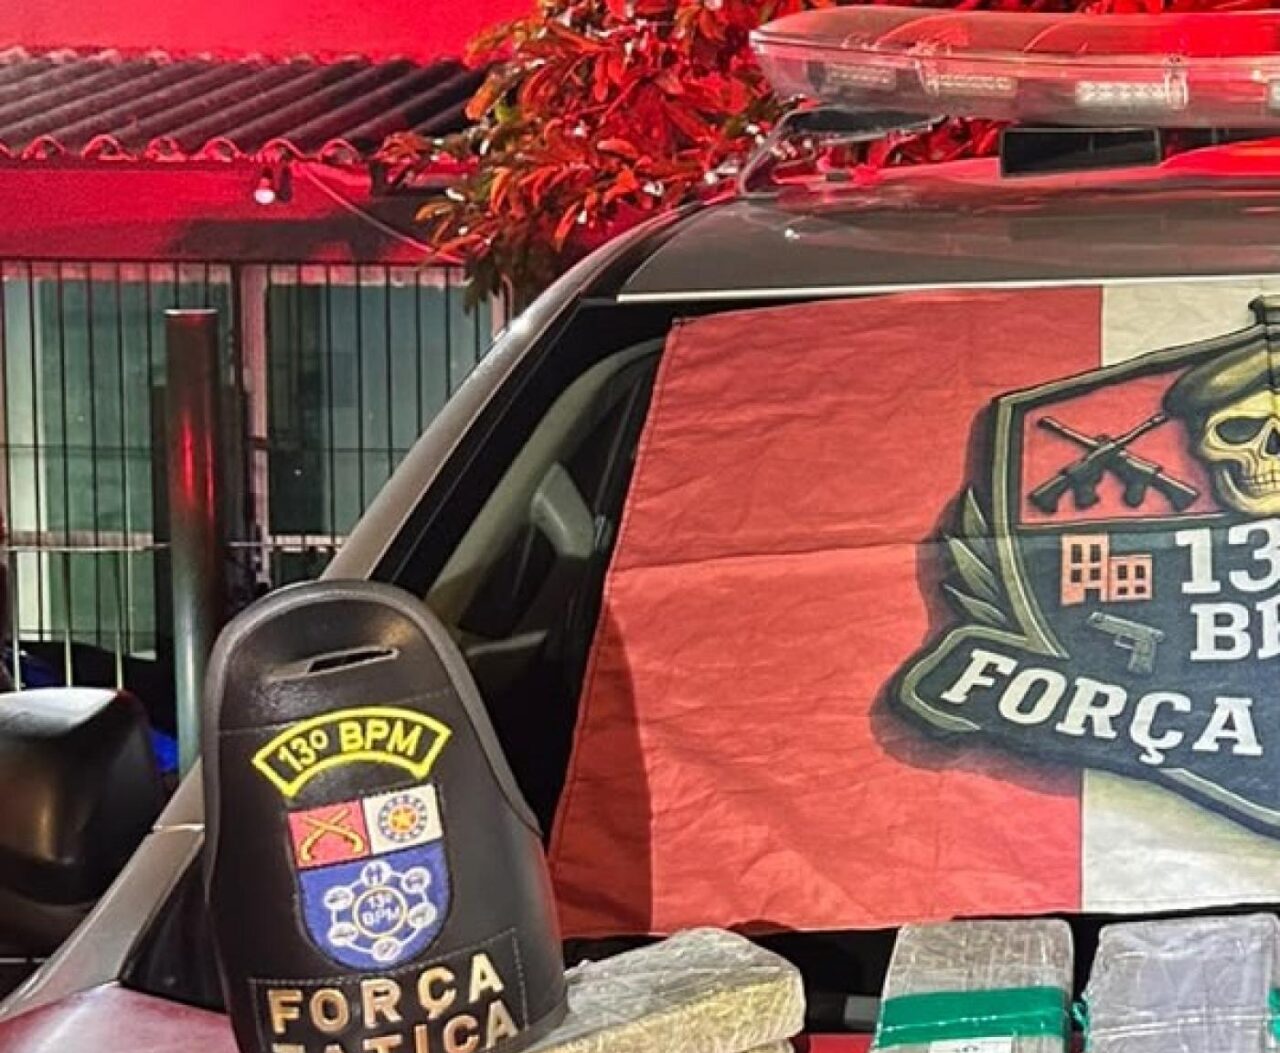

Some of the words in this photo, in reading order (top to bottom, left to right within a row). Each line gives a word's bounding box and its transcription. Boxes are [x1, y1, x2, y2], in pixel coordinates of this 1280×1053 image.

[338, 718, 421, 757] BPM
[939, 648, 1264, 764] FORÇA
[267, 952, 505, 1034] FORÇA
